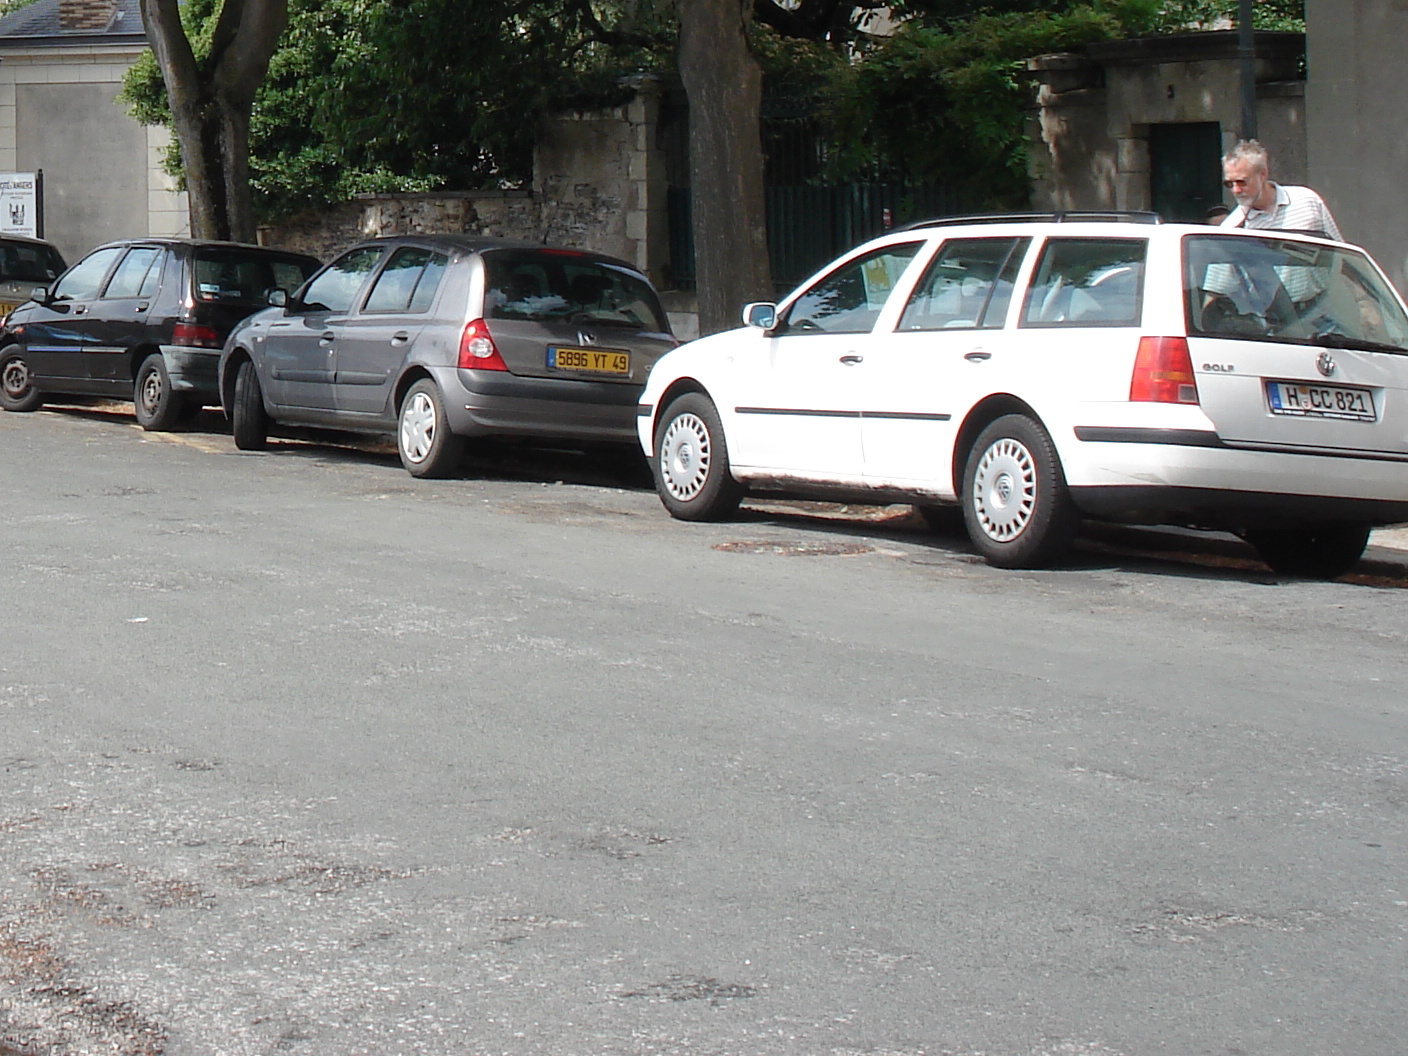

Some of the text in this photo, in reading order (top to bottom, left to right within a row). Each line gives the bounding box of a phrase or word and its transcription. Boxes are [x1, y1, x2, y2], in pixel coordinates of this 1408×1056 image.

[558, 351, 588, 367] 5896
[593, 353, 607, 369] YT
[612, 356, 627, 370] 49
[1202, 363, 1235, 372] GOLF
[1285, 386, 1300, 407] H
[1335, 391, 1368, 413] 821
